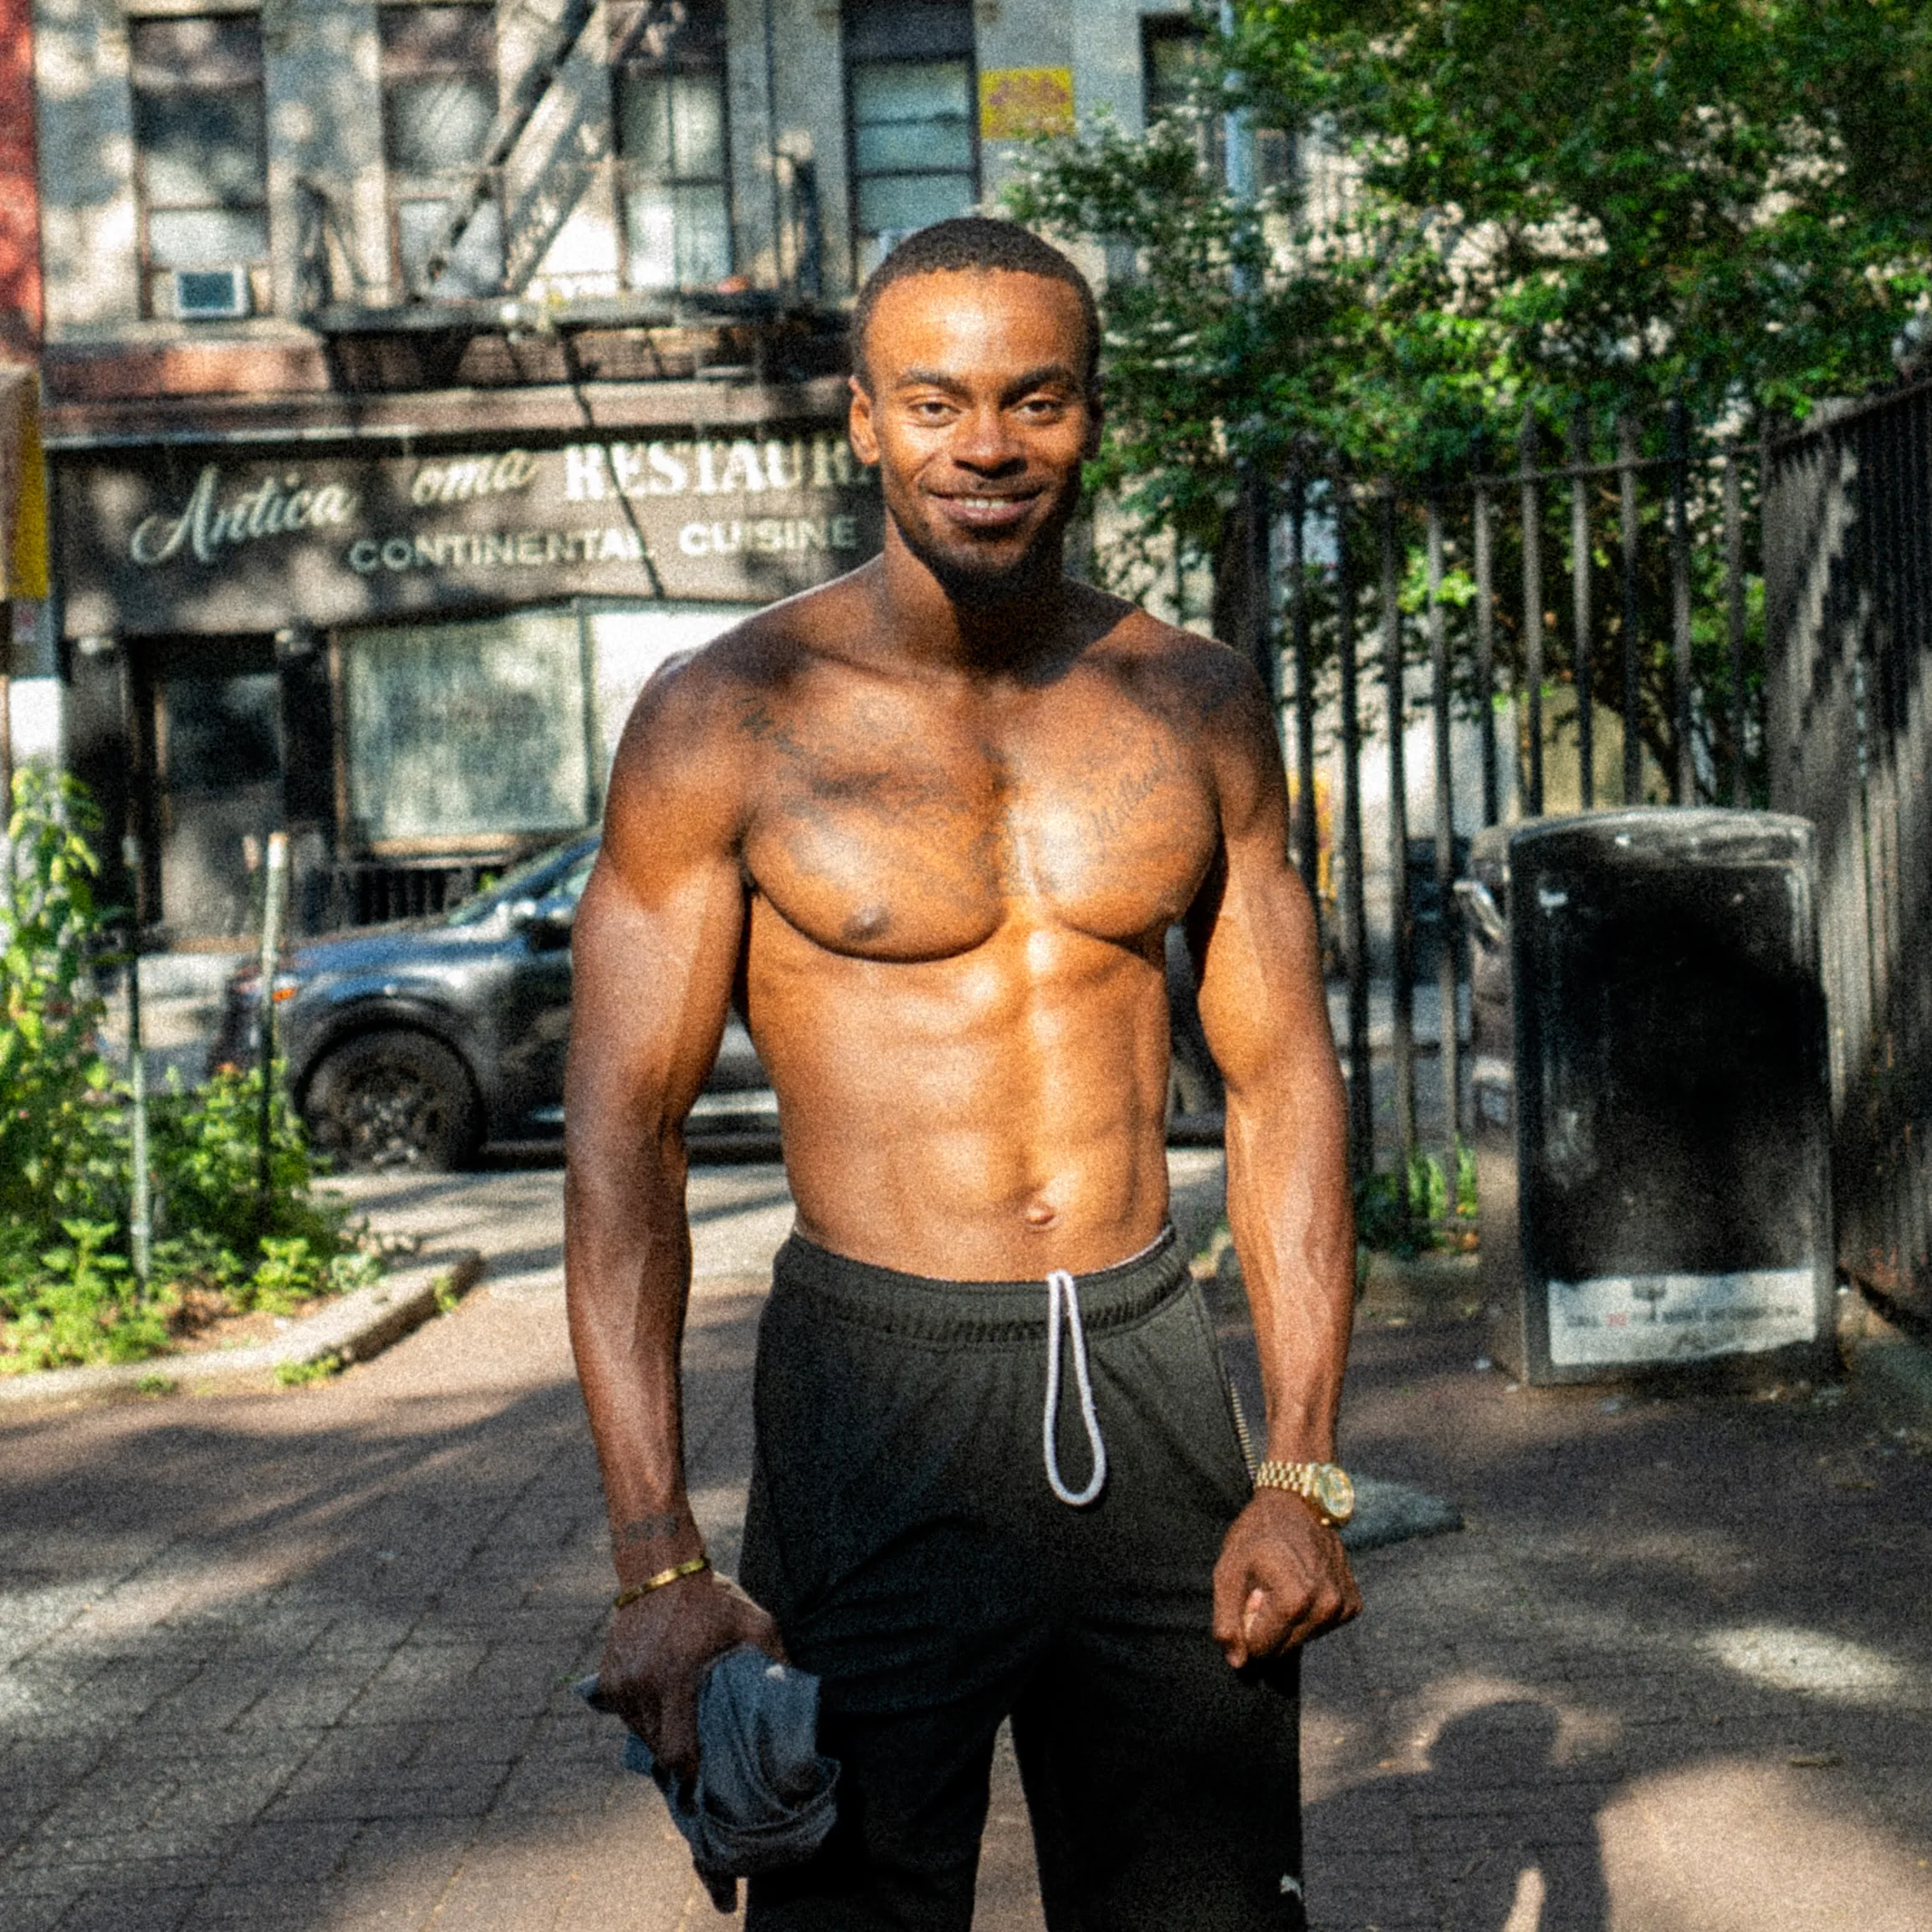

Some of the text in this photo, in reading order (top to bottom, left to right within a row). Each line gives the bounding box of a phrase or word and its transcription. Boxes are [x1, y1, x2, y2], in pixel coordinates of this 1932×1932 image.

[130, 465, 361, 564] Antica
[348, 515, 856, 573] CONTINENTAL CUISINE
